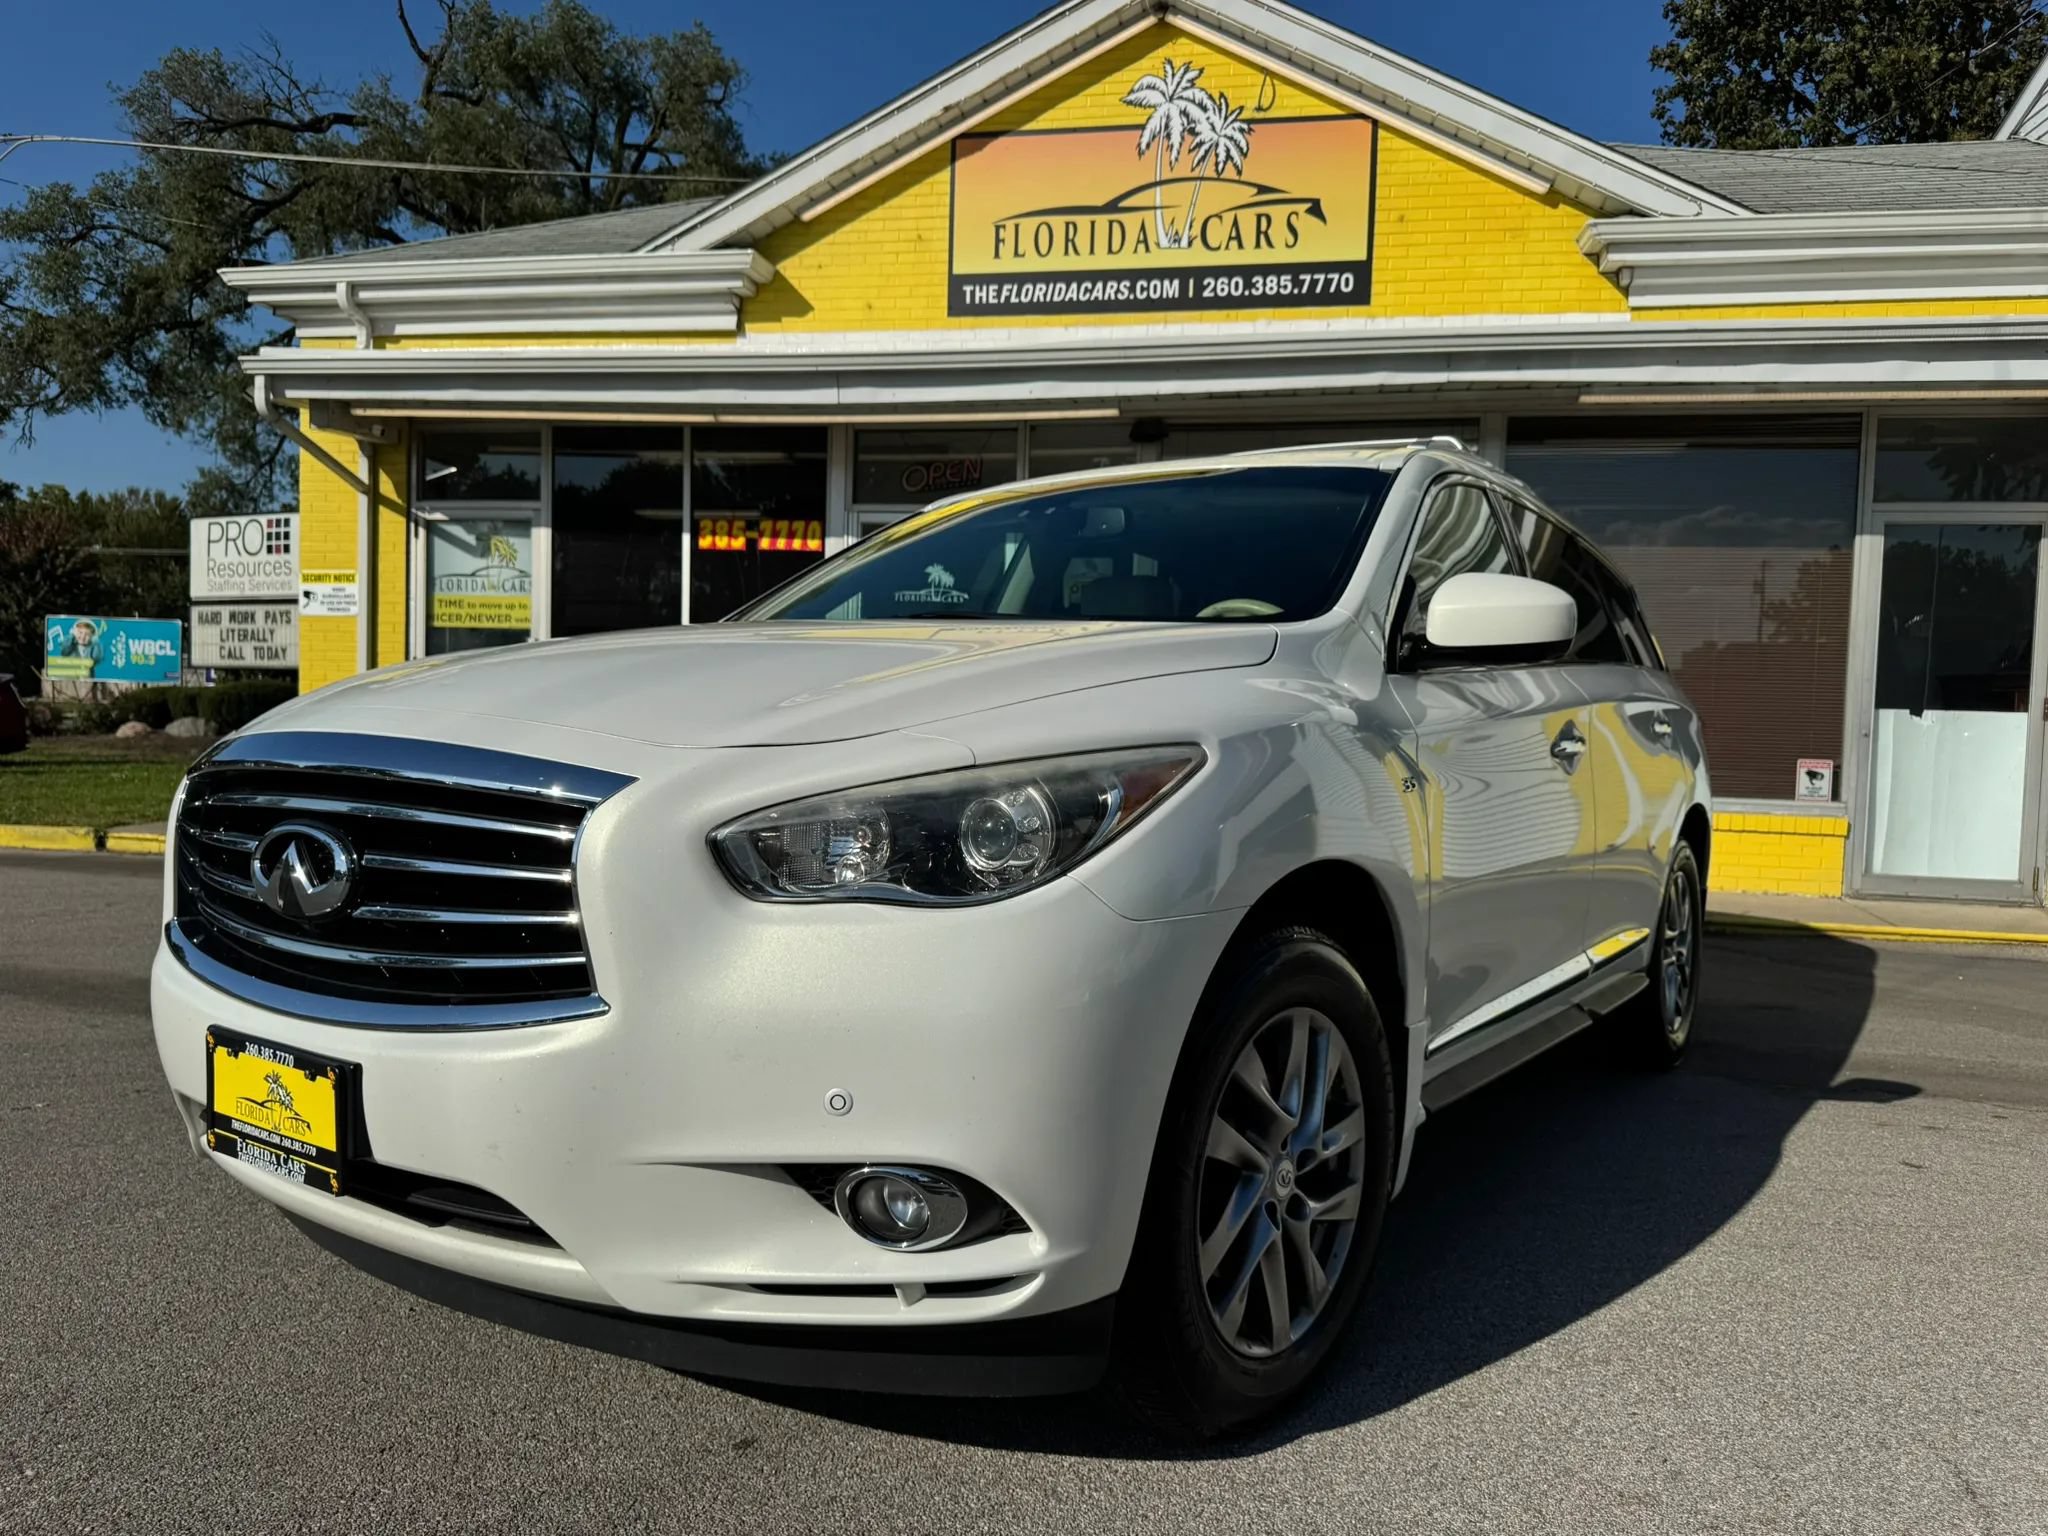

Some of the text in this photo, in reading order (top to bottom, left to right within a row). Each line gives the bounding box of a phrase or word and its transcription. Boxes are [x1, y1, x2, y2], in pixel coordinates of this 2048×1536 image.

[992, 211, 1301, 260] FLORIDA CARS
[962, 277, 1180, 305] THEFLORIDACARS.COM
[1201, 271, 1355, 299] 260.385.7770
[902, 456, 982, 492] OPEN
[207, 519, 265, 557] PRO
[698, 519, 822, 550] 385-7770
[206, 558, 293, 579] Resources
[302, 573, 355, 584] SECURITY NOTICE
[206, 578, 293, 595] Staffing Services
[437, 598, 465, 610] TIME
[479, 602, 503, 610] move
[505, 602, 517, 612] up
[197, 609, 292, 625] HARD WORK PAYS
[219, 626, 275, 643] LITERALLY
[128, 638, 177, 657] WBCL
[219, 644, 287, 661] CALL TODAY
[130, 654, 156, 666] 90.3
[245, 1042, 295, 1068] 260.385.7770
[236, 1100, 307, 1136] FLORIDA CARS
[231, 1119, 317, 1157] THEFLORIDACARS.COM 260.385.7770
[238, 1152, 305, 1184] THEFLORIDACARS.COM
